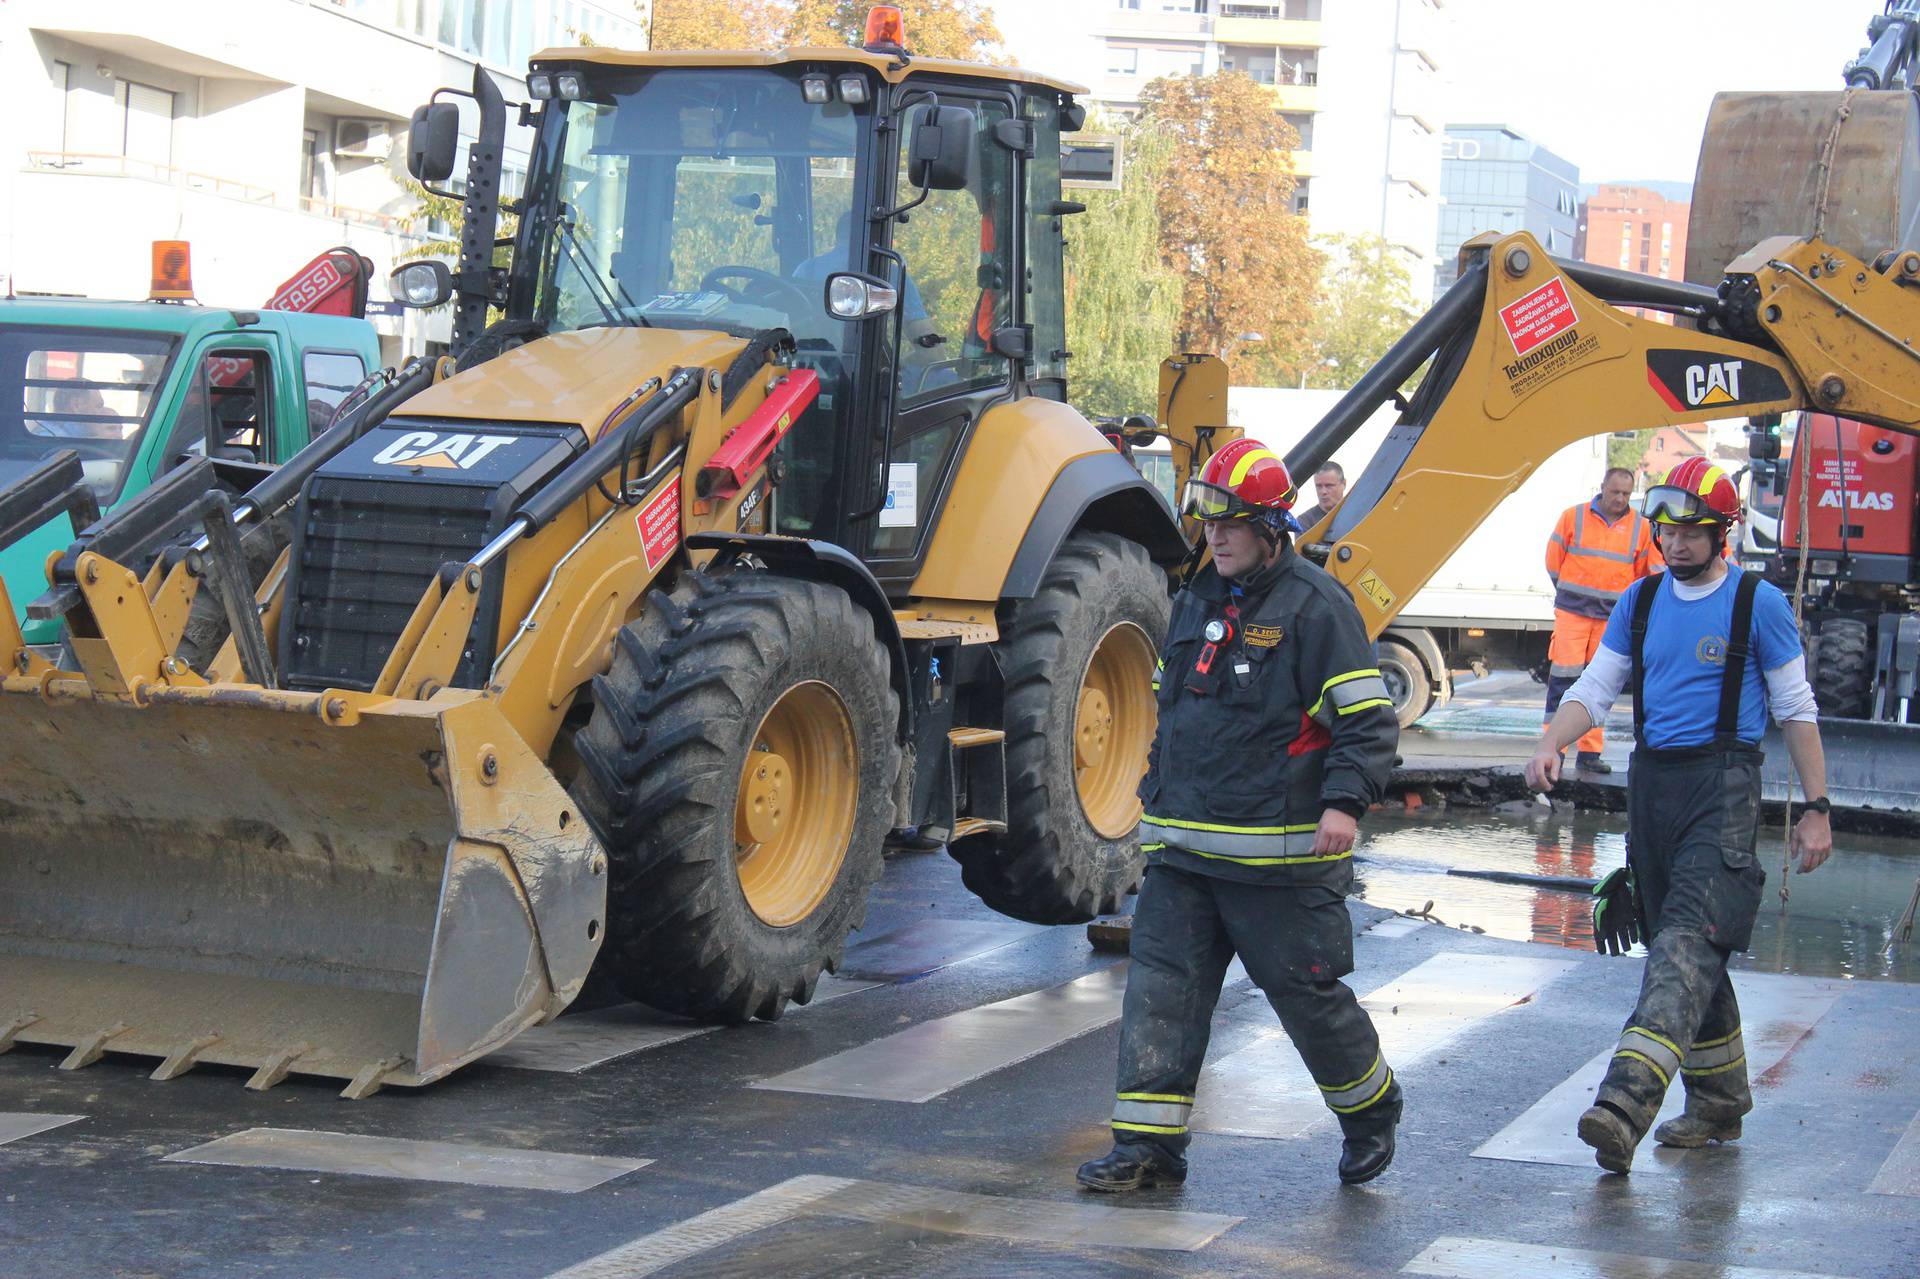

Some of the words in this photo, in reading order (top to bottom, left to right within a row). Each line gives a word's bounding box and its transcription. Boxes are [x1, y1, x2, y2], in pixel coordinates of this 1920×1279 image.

[1512, 292, 1547, 318] ZABRANJENO
[1546, 288, 1554, 297] JE
[1546, 299, 1555, 308] SE
[1512, 322, 1535, 340] RADNOM
[1535, 302, 1569, 327] DJELOKRUGU
[1534, 322, 1555, 338] STROJA
[1502, 329, 1579, 380] Teknoxgroup
[1510, 371, 1539, 391] PRODAJA
[1543, 355, 1565, 370] SERVIS
[1569, 335, 1597, 356] DIJELOVI
[1685, 361, 1742, 406] CAT
[372, 431, 519, 470] CAT
[645, 491, 672, 524] ZABRANJENO
[671, 487, 677, 497] JE
[740, 490, 757, 518] 434F
[1817, 489, 1894, 511] ATLAS
[645, 528, 662, 551] RADNOM
[661, 529, 678, 548] STROJA
